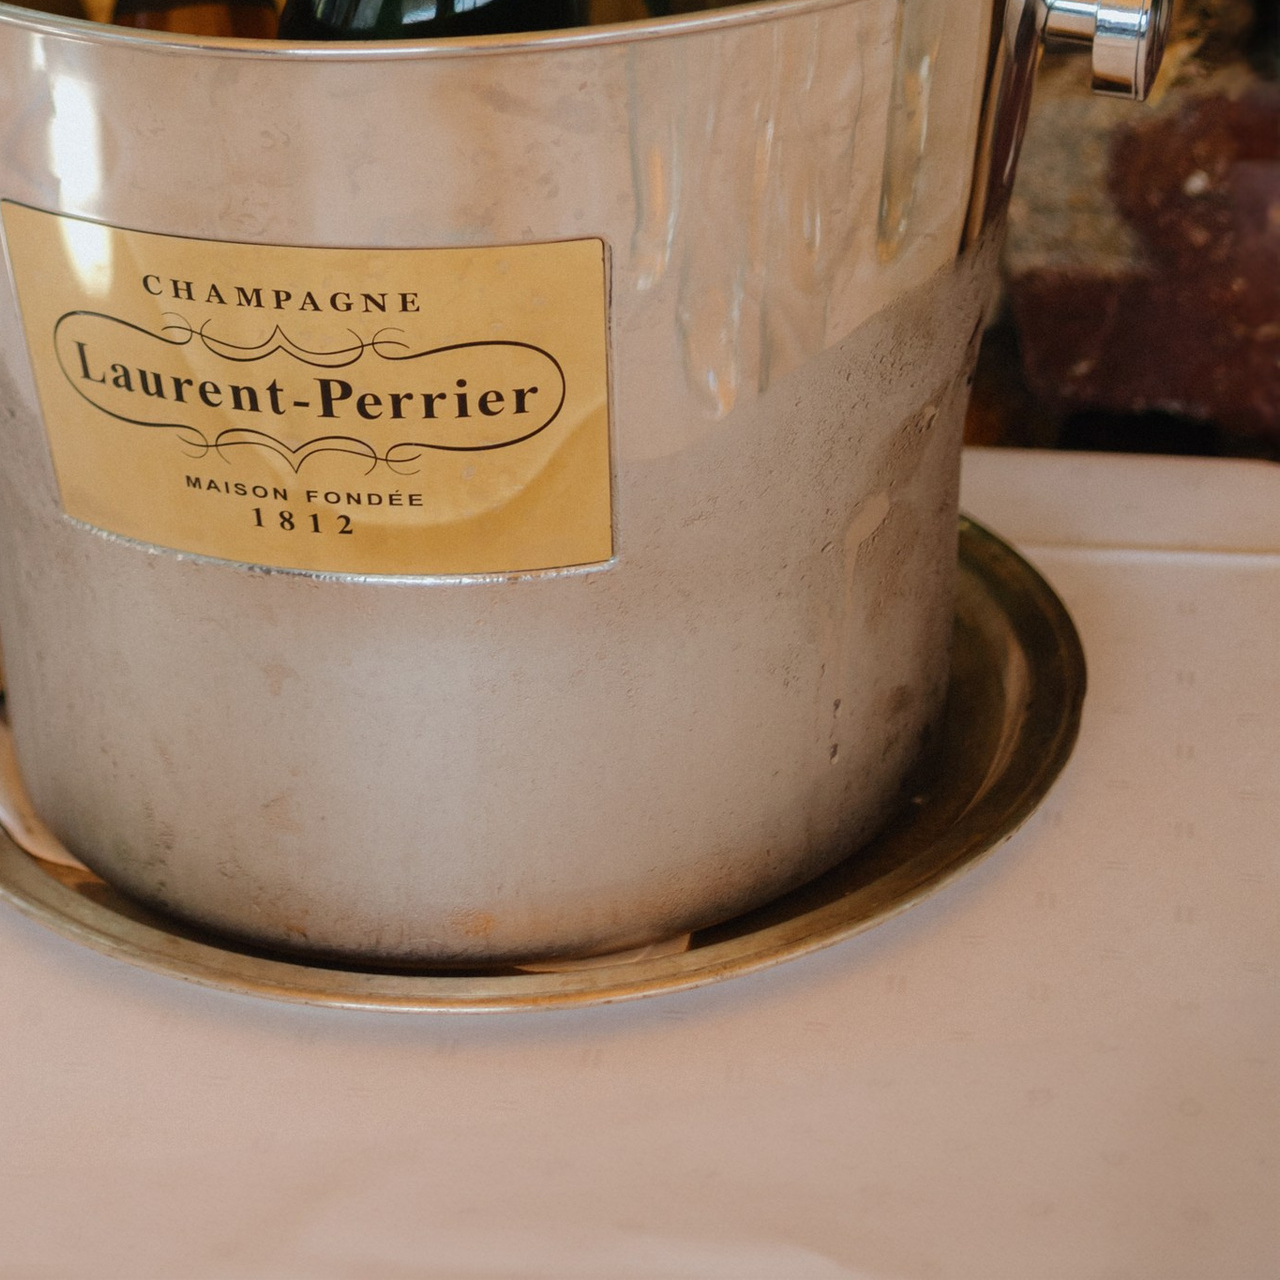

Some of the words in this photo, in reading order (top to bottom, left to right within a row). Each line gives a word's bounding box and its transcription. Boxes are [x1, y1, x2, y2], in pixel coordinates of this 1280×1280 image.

[141, 273, 421, 314] CHAMPAGNE
[74, 340, 540, 422] Laurent-Perrier
[185, 474, 289, 503] MAISON
[305, 488, 425, 508] FONDÉE
[251, 506, 355, 536] 1812
